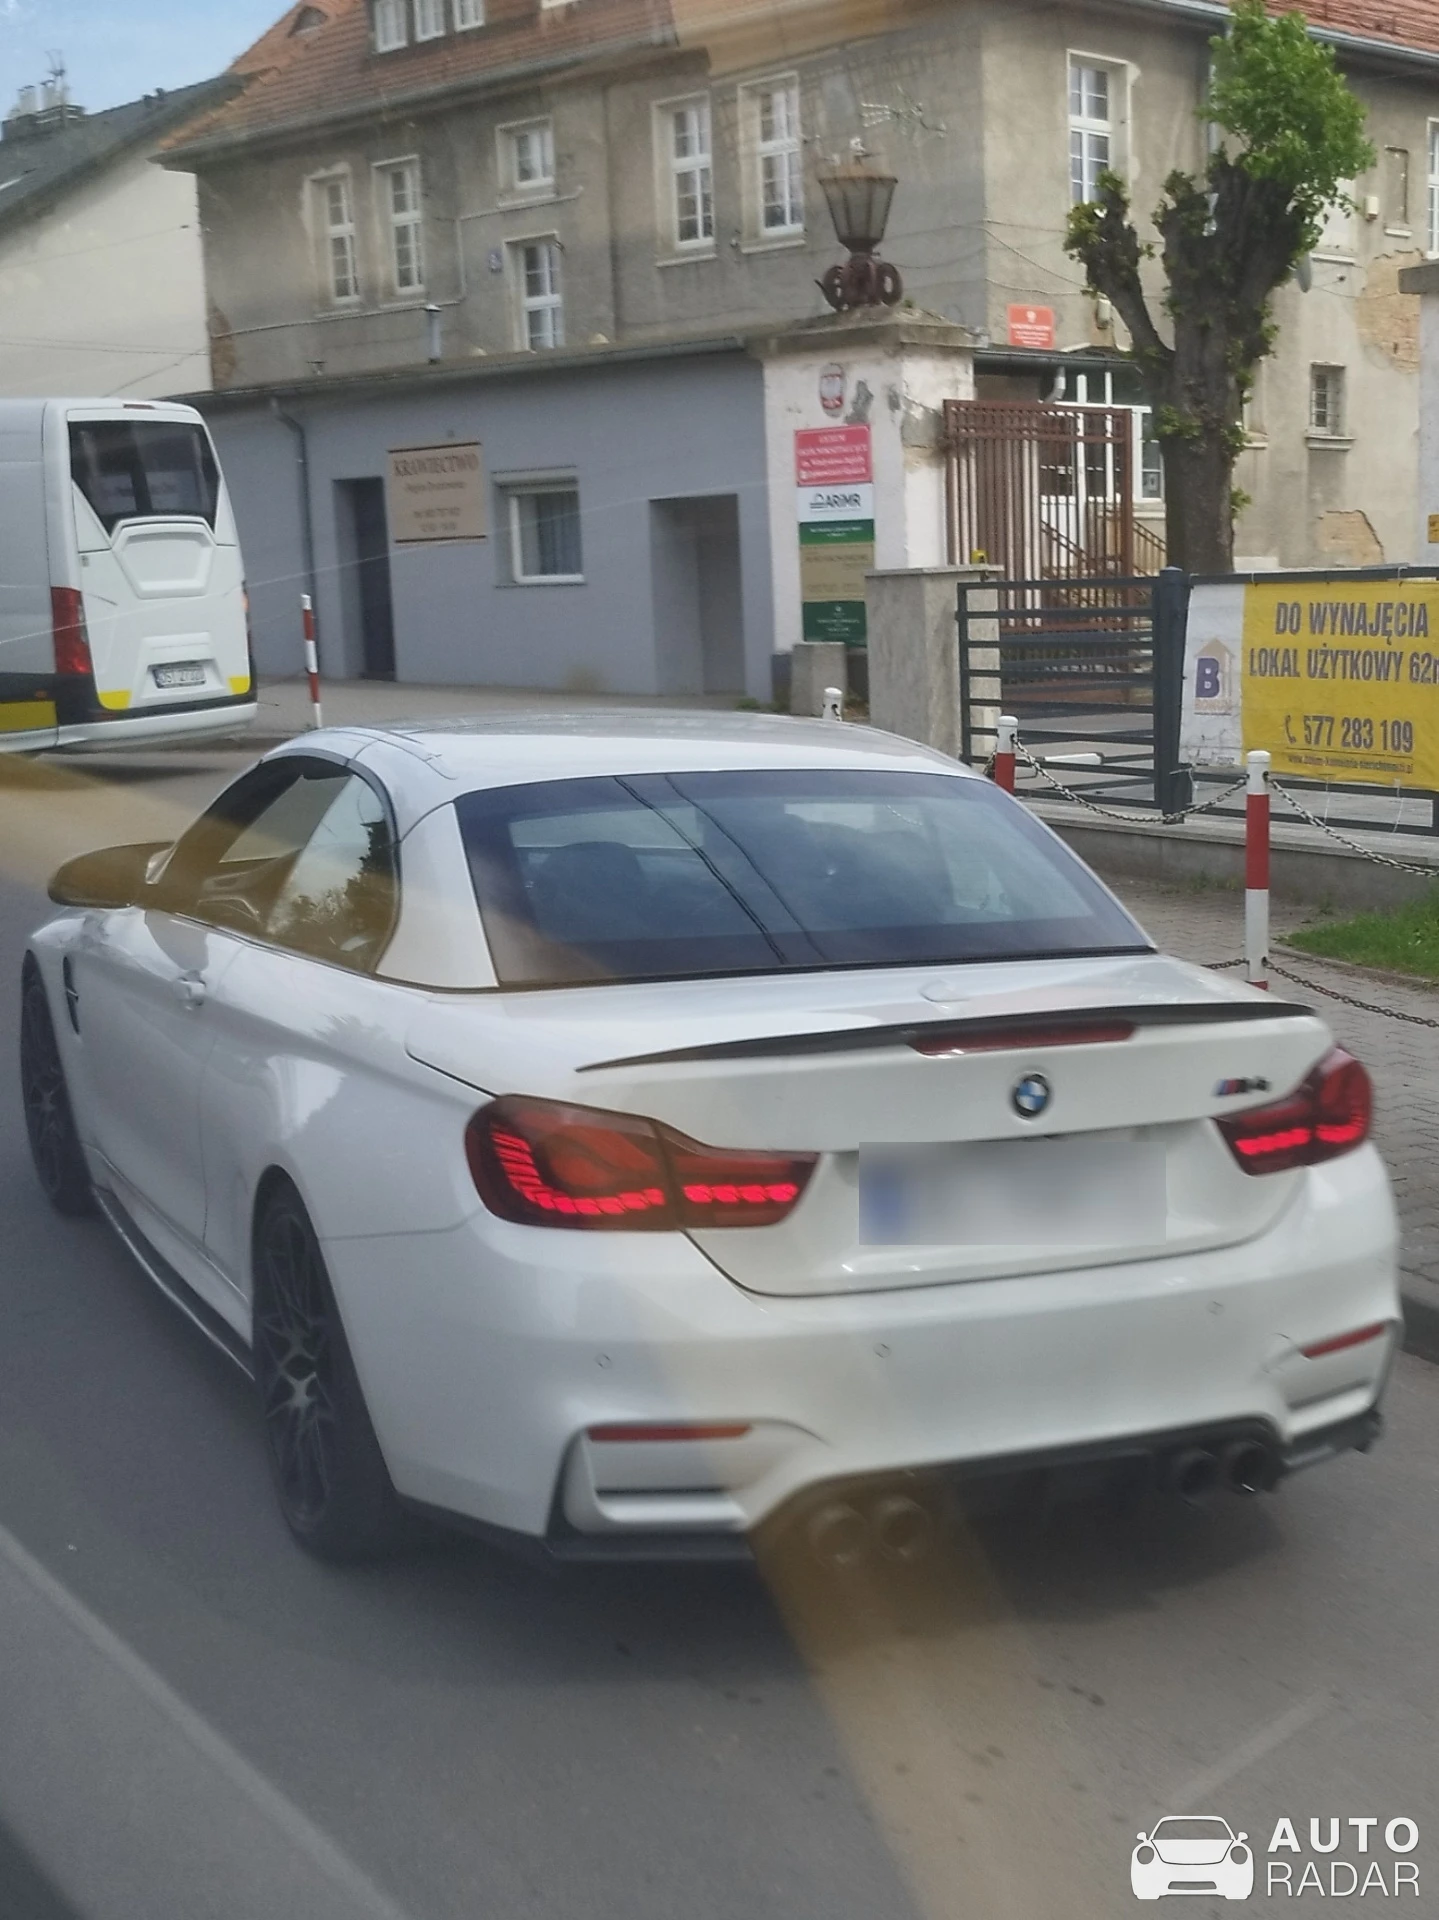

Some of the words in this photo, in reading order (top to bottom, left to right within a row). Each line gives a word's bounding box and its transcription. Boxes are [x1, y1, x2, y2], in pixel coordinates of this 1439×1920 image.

[1275, 602, 1301, 635] DO
[1308, 602, 1429, 646] WYNAJĘCIA
[1250, 648, 1300, 678] LOKAL
[1307, 643, 1404, 682] UŻYTKOWY
[1303, 715, 1335, 747] 577
[1341, 717, 1373, 750] 283
[1380, 719, 1413, 753] 109
